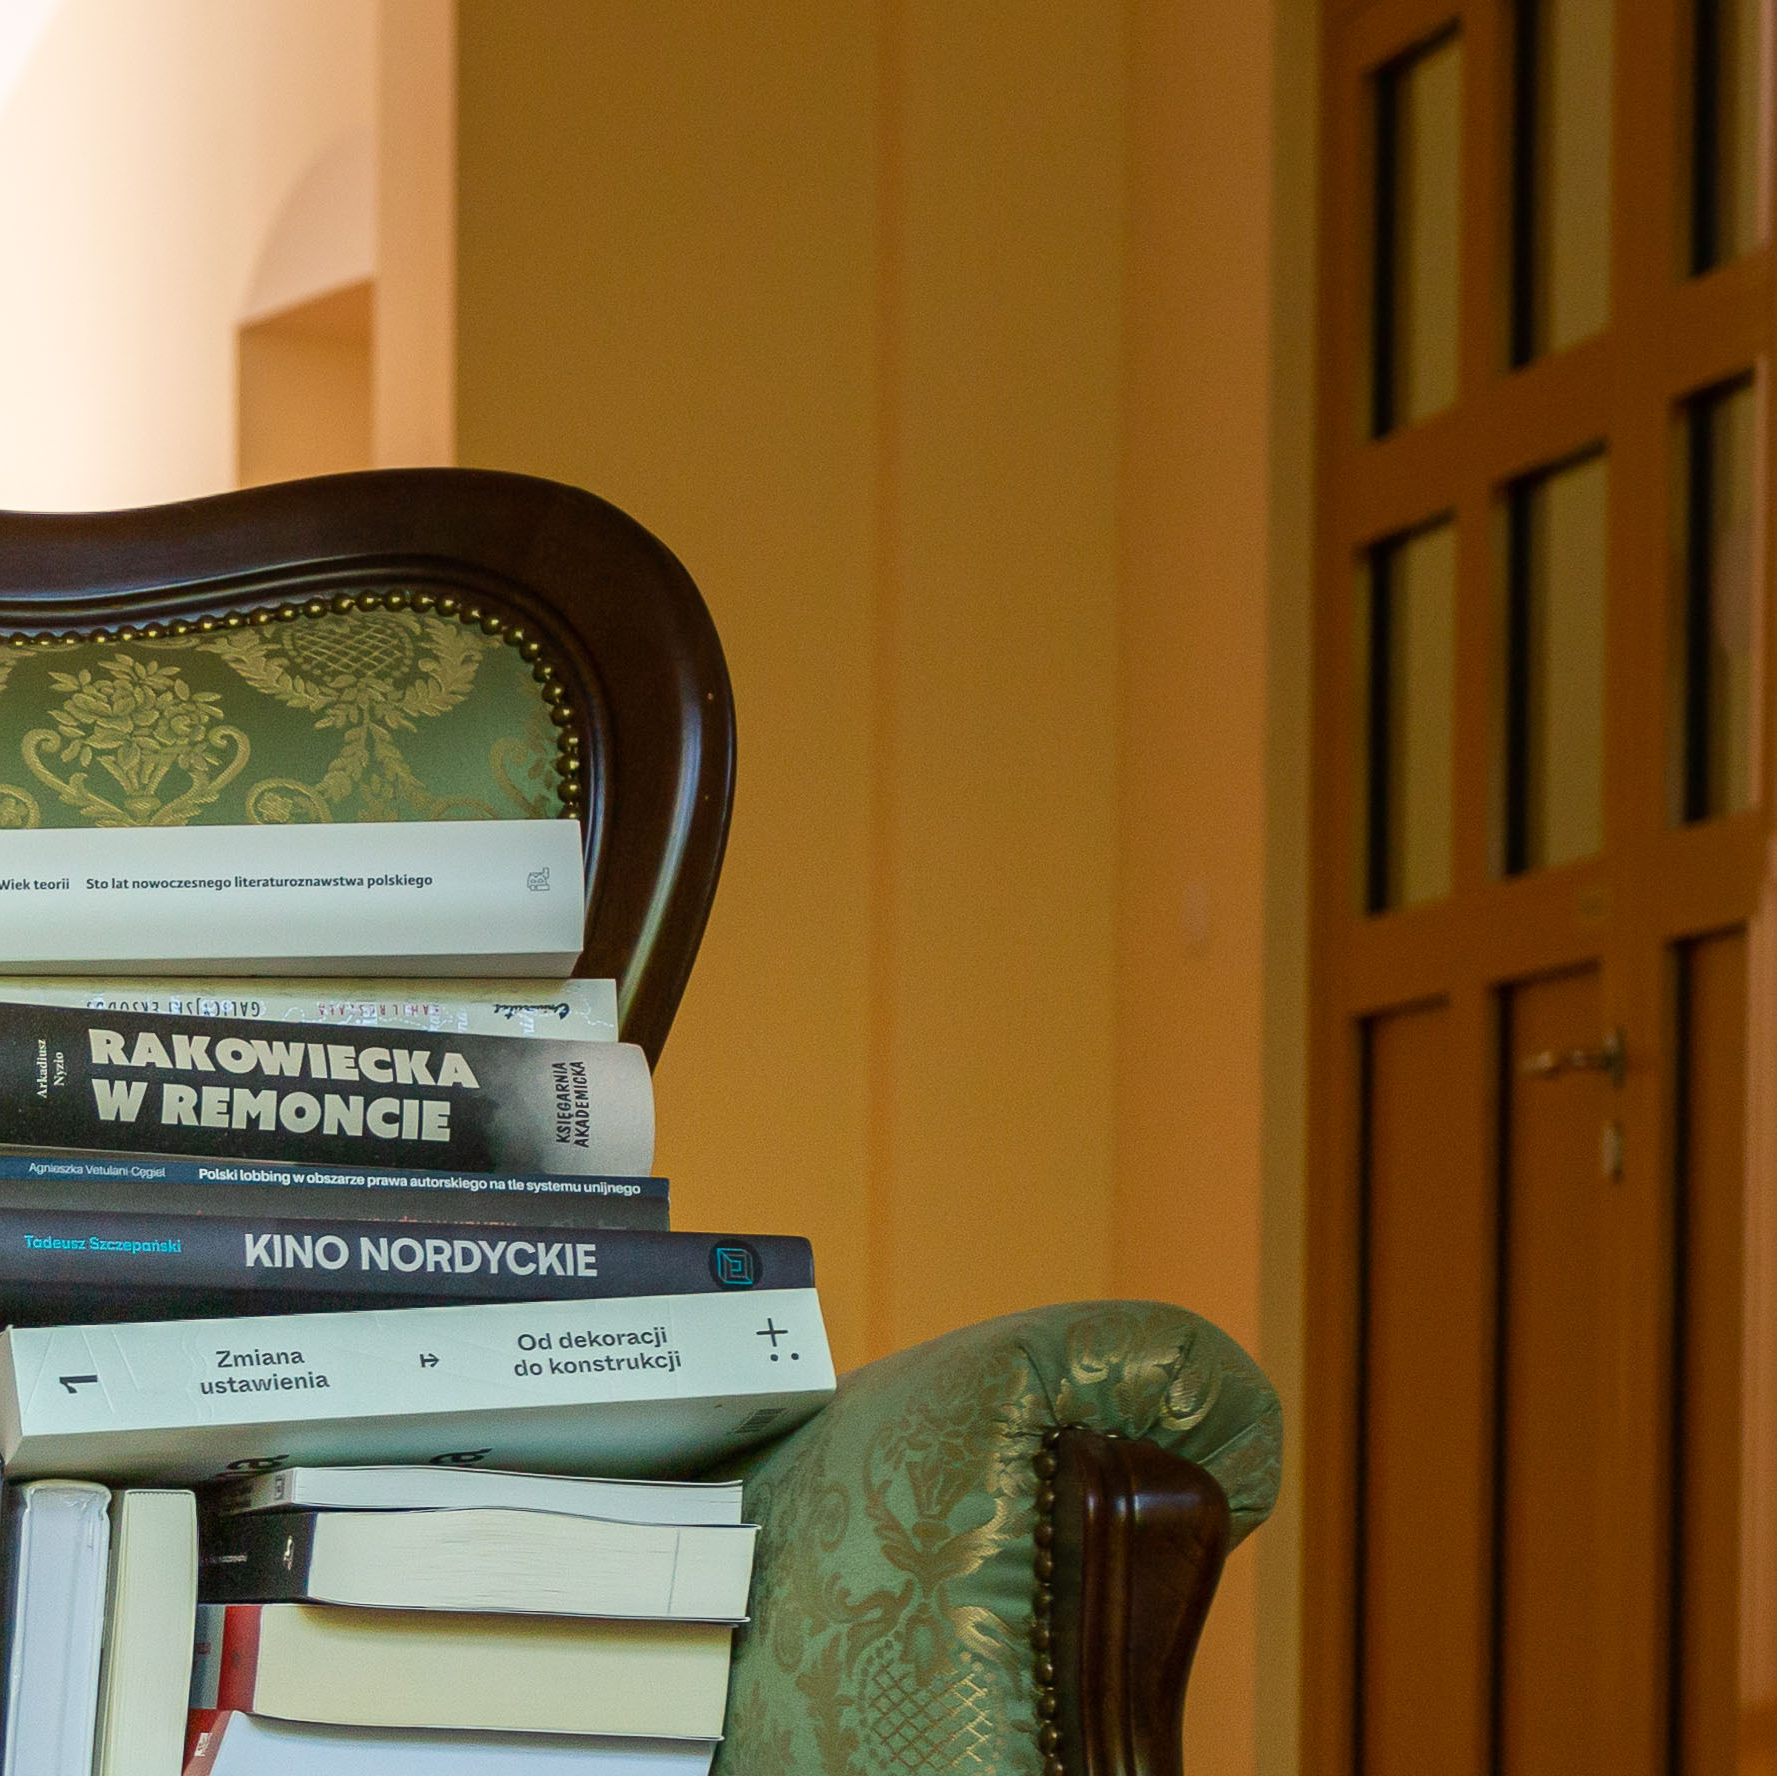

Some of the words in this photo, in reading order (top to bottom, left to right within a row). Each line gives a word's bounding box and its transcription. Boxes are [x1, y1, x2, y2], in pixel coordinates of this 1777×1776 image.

[33, 877, 70, 891] teorii
[86, 877, 108, 890] Sto
[110, 877, 130, 890] lat
[132, 876, 231, 893] nowoczesnego
[234, 874, 364, 890] literaturoznawstwa
[366, 872, 433, 891] polskiego
[36, 1039, 48, 1098] Arkadiusz
[53, 1051, 67, 1087] Nyzio
[88, 1028, 479, 1088] RAKOWIECKA
[91, 1079, 148, 1123] W
[161, 1083, 451, 1142] REMONCIE
[551, 1062, 574, 1143] KSIĘGARNIA
[569, 1061, 590, 1148] AKADEMICKA
[28, 1163, 83, 1176] Agnieszka
[199, 1169, 238, 1180] Polski
[240, 1170, 290, 1185] lobbing
[292, 1174, 305, 1183] w
[307, 1172, 365, 1184] obszarze
[367, 1176, 407, 1186] prawa
[410, 1176, 487, 1192] autorskiego
[490, 1181, 506, 1190] na
[507, 1179, 525, 1191] tle
[526, 1181, 582, 1195] systemu
[584, 1183, 641, 1197] unijnego
[24, 1235, 85, 1249] Tadeusz
[89, 1237, 181, 1255] Szczepański
[244, 1233, 353, 1271] KINO
[362, 1237, 598, 1278] NORDYCKIE
[517, 1332, 553, 1352] Od
[558, 1327, 668, 1350] dekoracji
[216, 1347, 305, 1370] Zmiana
[513, 1356, 543, 1378] do
[548, 1350, 682, 1377] konstrukcji
[59, 1373, 98, 1395] 1
[199, 1370, 329, 1394] ustawienia
